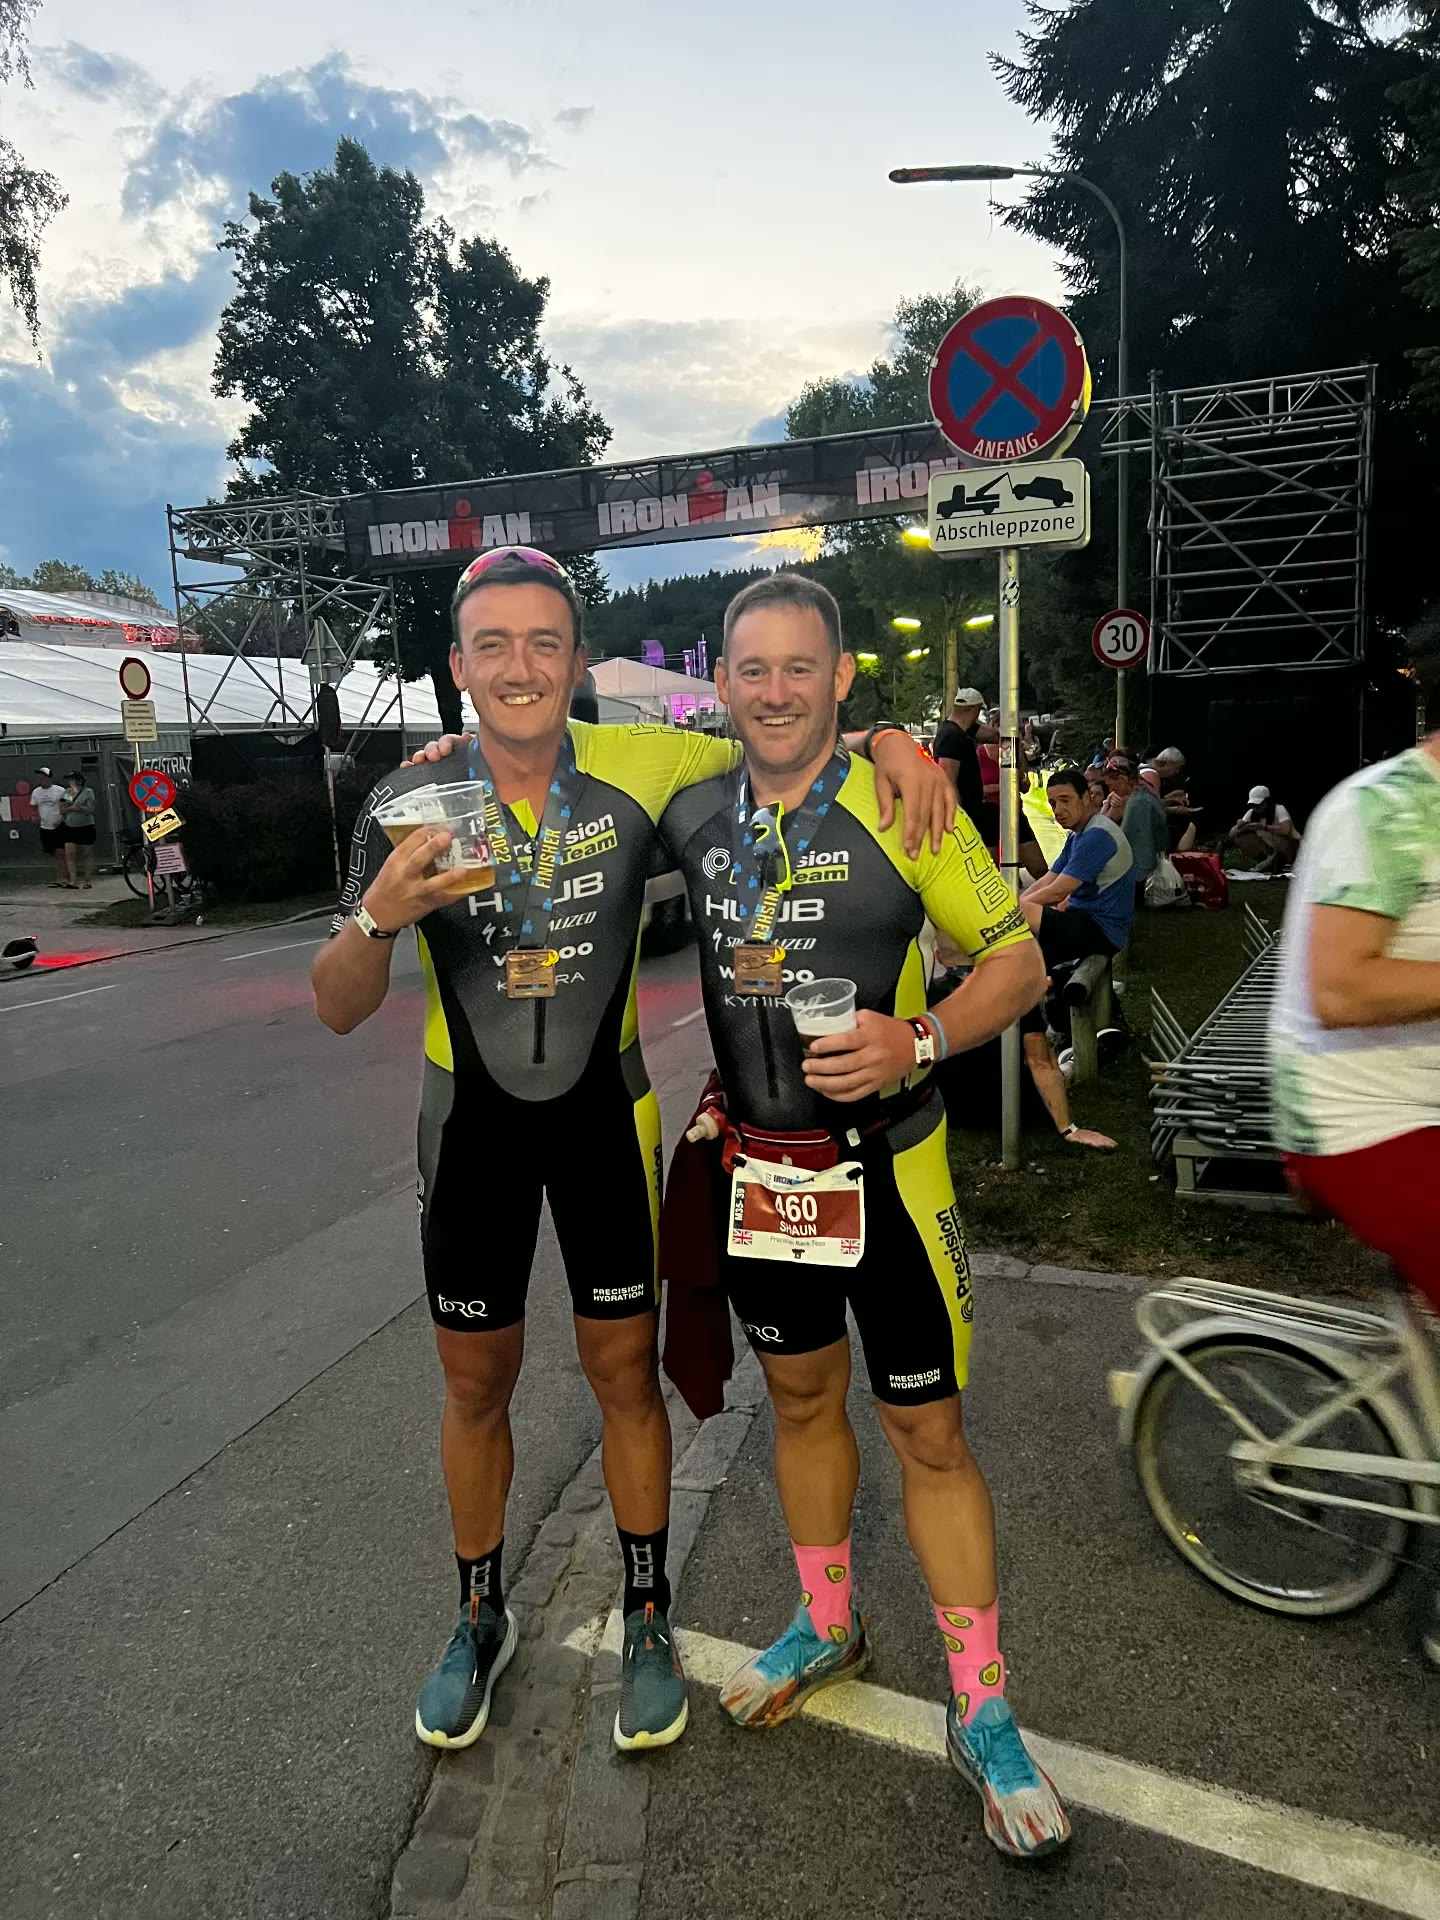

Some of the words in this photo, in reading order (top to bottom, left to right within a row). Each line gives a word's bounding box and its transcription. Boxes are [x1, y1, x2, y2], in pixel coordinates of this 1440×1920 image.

[972, 432, 1039, 458] ANFANG
[597, 471, 781, 536] IRONMAN
[367, 500, 532, 556] IRONMAN
[935, 516, 1075, 541] Abschleppzone
[1107, 623, 1137, 653] 30
[488, 832, 512, 864] 2022
[534, 828, 561, 889] FINISHER
[775, 1194, 818, 1222] 460
[780, 1220, 817, 1236] SHAUN
[936, 1208, 968, 1300] Precision
[593, 1284, 644, 1296] PRECISION
[593, 1290, 644, 1302] HYDRATION
[889, 1368, 940, 1382] PRECISION
[890, 1375, 941, 1389] HYDRATION
